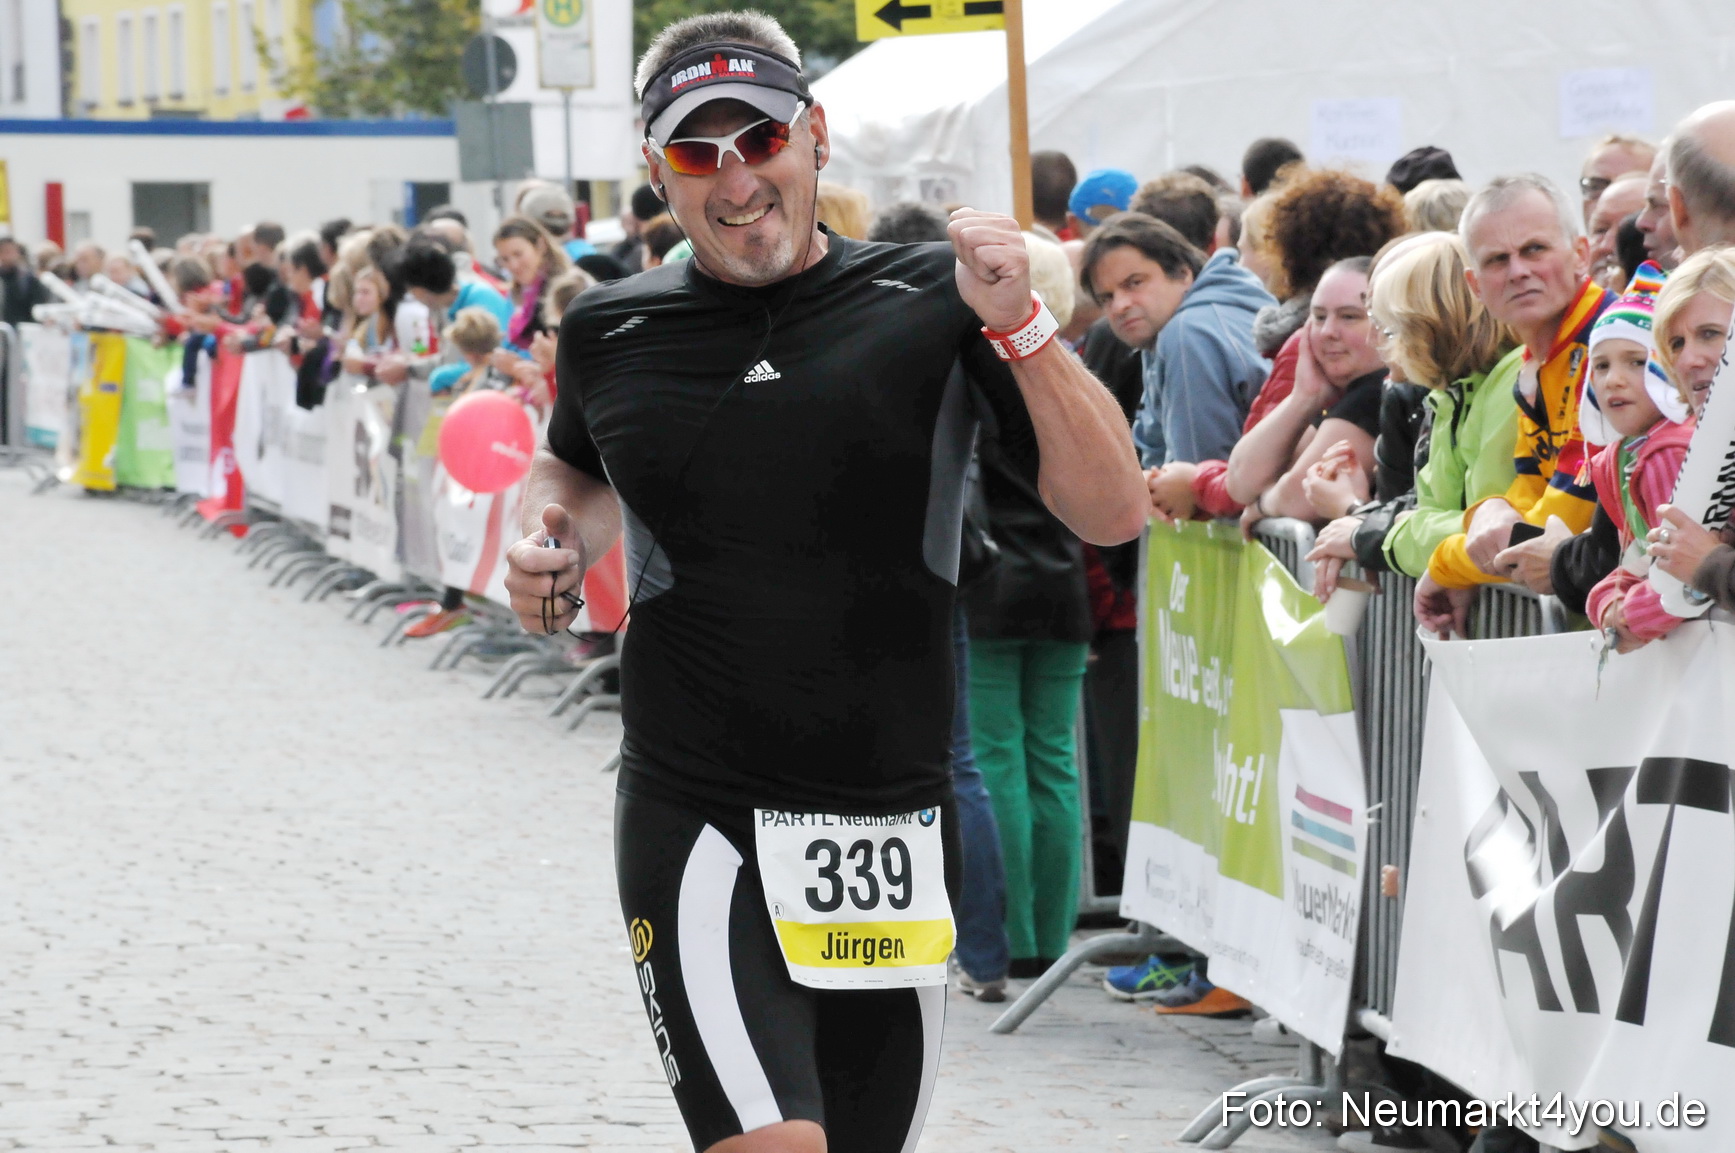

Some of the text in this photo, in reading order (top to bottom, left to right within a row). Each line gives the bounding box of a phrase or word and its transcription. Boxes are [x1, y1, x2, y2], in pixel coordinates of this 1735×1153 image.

[671, 54, 754, 88] IRONMAN
[744, 372, 781, 383] adidas
[804, 836, 913, 913] 339
[820, 932, 906, 966] Jürgen
